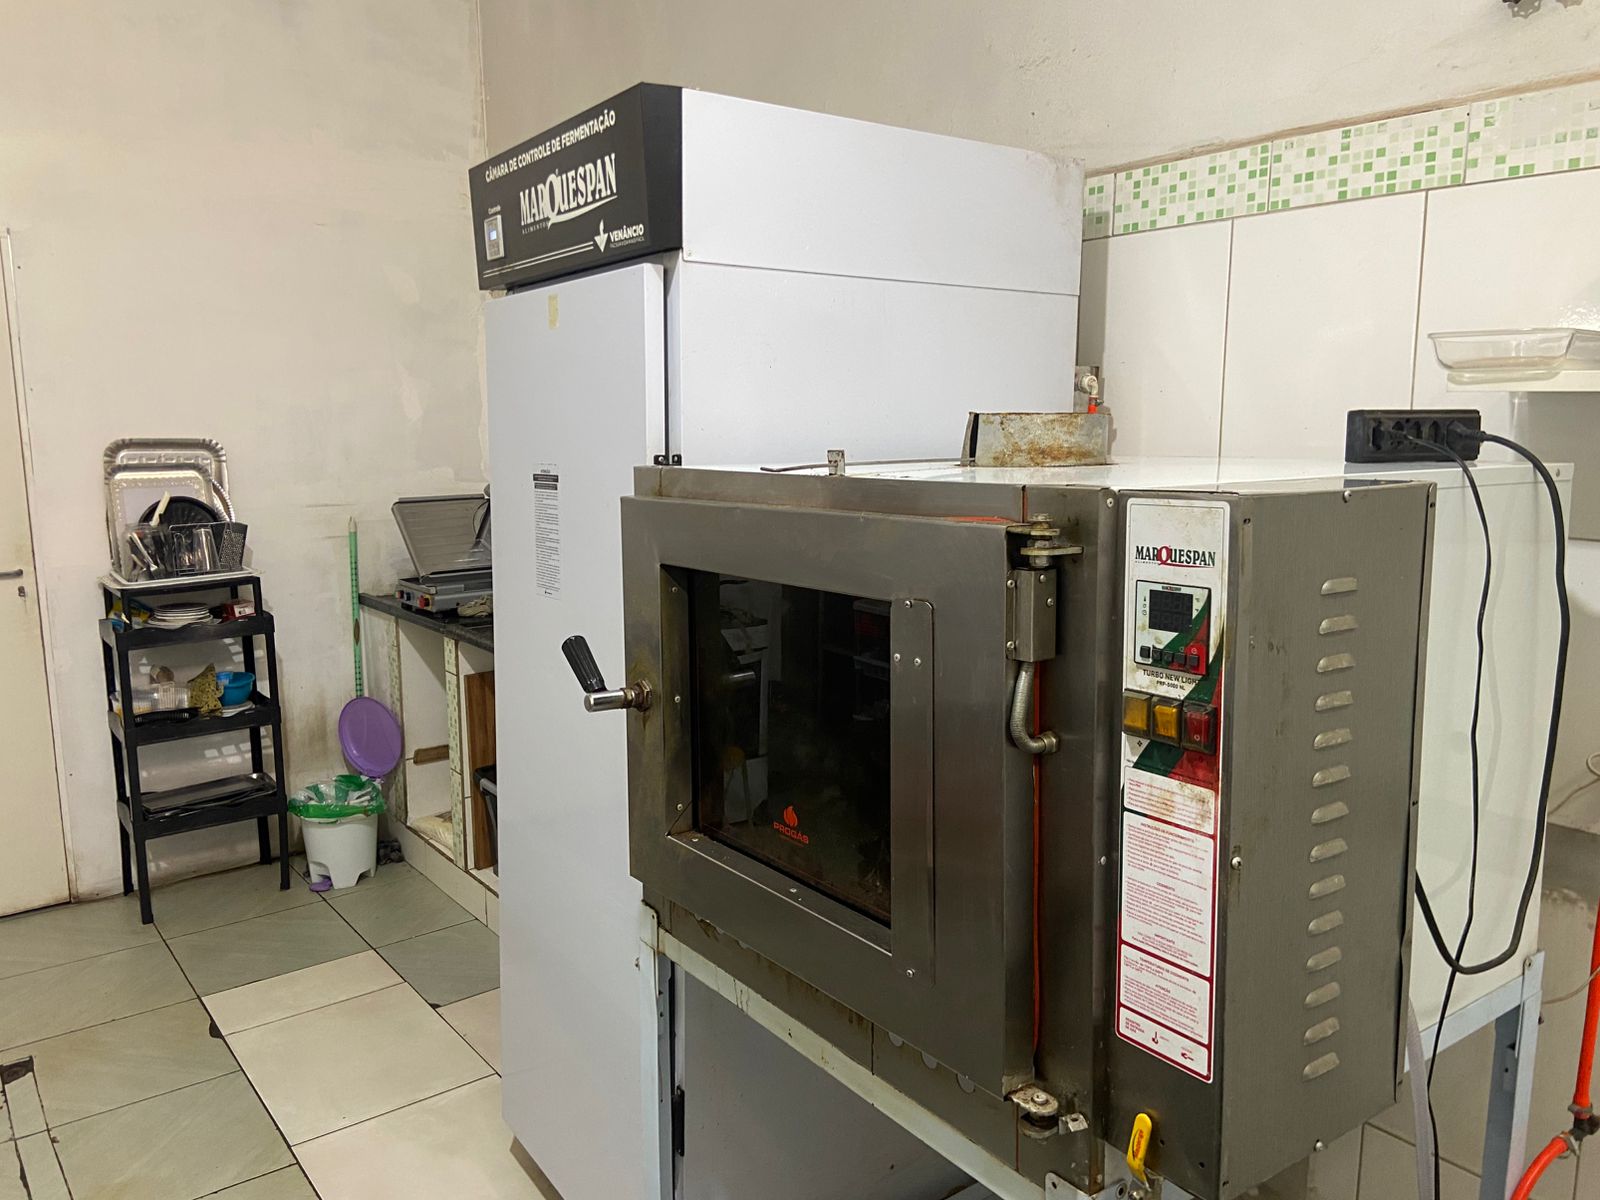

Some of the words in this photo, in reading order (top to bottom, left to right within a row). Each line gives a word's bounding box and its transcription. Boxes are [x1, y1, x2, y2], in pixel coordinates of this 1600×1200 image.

[485, 163, 508, 182] CÂMARA
[509, 160, 517, 172] DE
[518, 143, 551, 168] CONTROLE
[552, 138, 561, 152] DE
[561, 109, 616, 148] FERMENTAÇÃO
[520, 153, 618, 226] MARQUESPAN
[610, 223, 644, 242] VENÂNCIO
[1135, 546, 1216, 568] MARQUESPAN
[1143, 669, 1163, 679] TURBO
[1165, 674, 1181, 682] NEW
